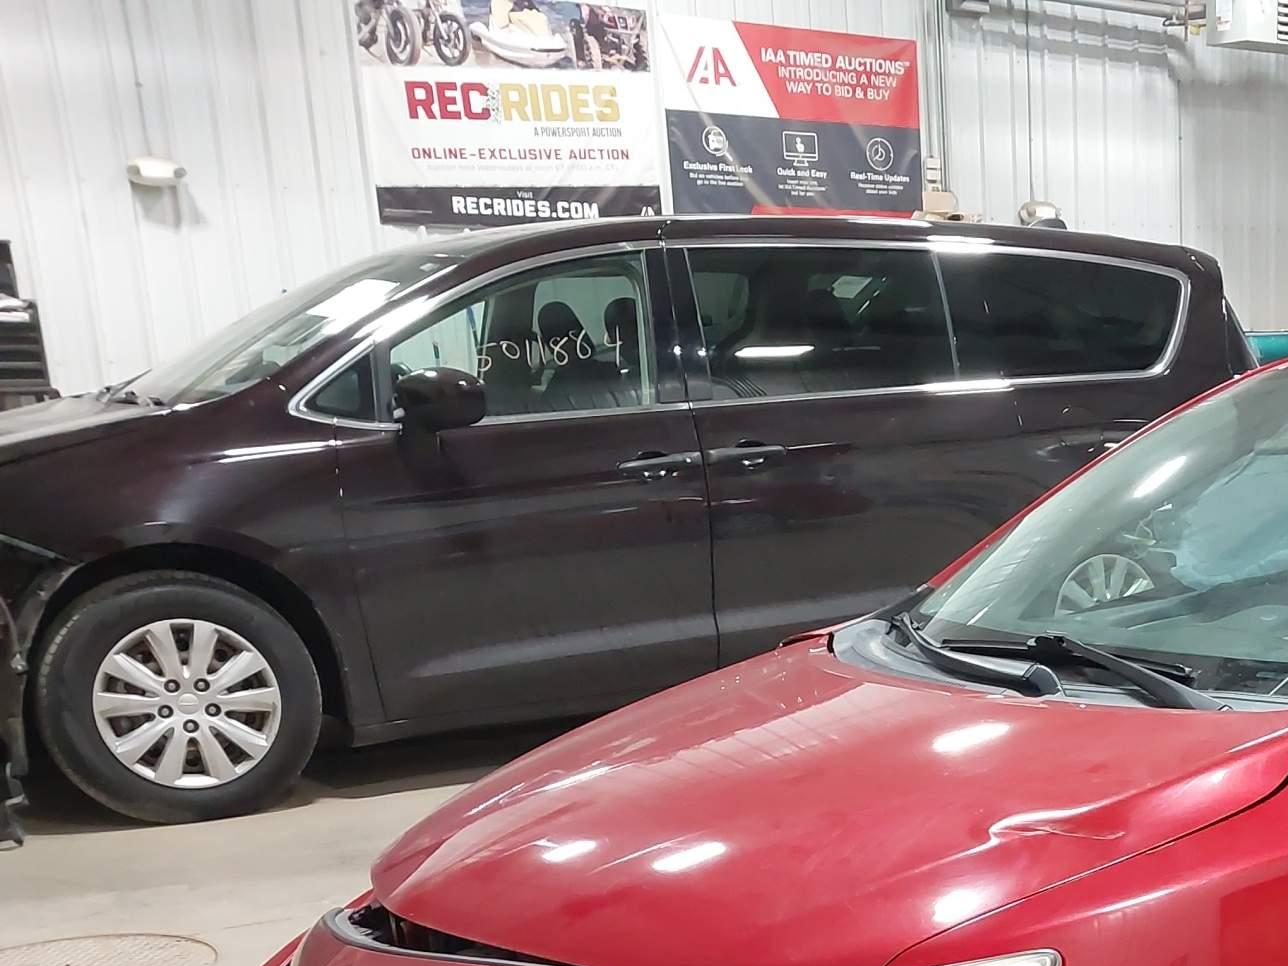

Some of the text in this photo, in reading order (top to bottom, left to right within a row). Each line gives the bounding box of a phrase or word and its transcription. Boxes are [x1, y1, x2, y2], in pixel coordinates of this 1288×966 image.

[760, 48, 786, 63] IAA
[786, 50, 832, 68] TIMED
[778, 66, 897, 88] INTRODUCING A NEW
[785, 81, 890, 100] WAY TO BID & BUY
[534, 127, 622, 138] A POWERSPORT AUCTION
[411, 147, 630, 161] ONLINE-EXCLUSIVE AUCTION
[777, 167, 796, 177] Quick
[810, 170, 828, 180] Easy
[516, 190, 533, 200] Visit
[451, 196, 600, 220] RECRIDES.COM
